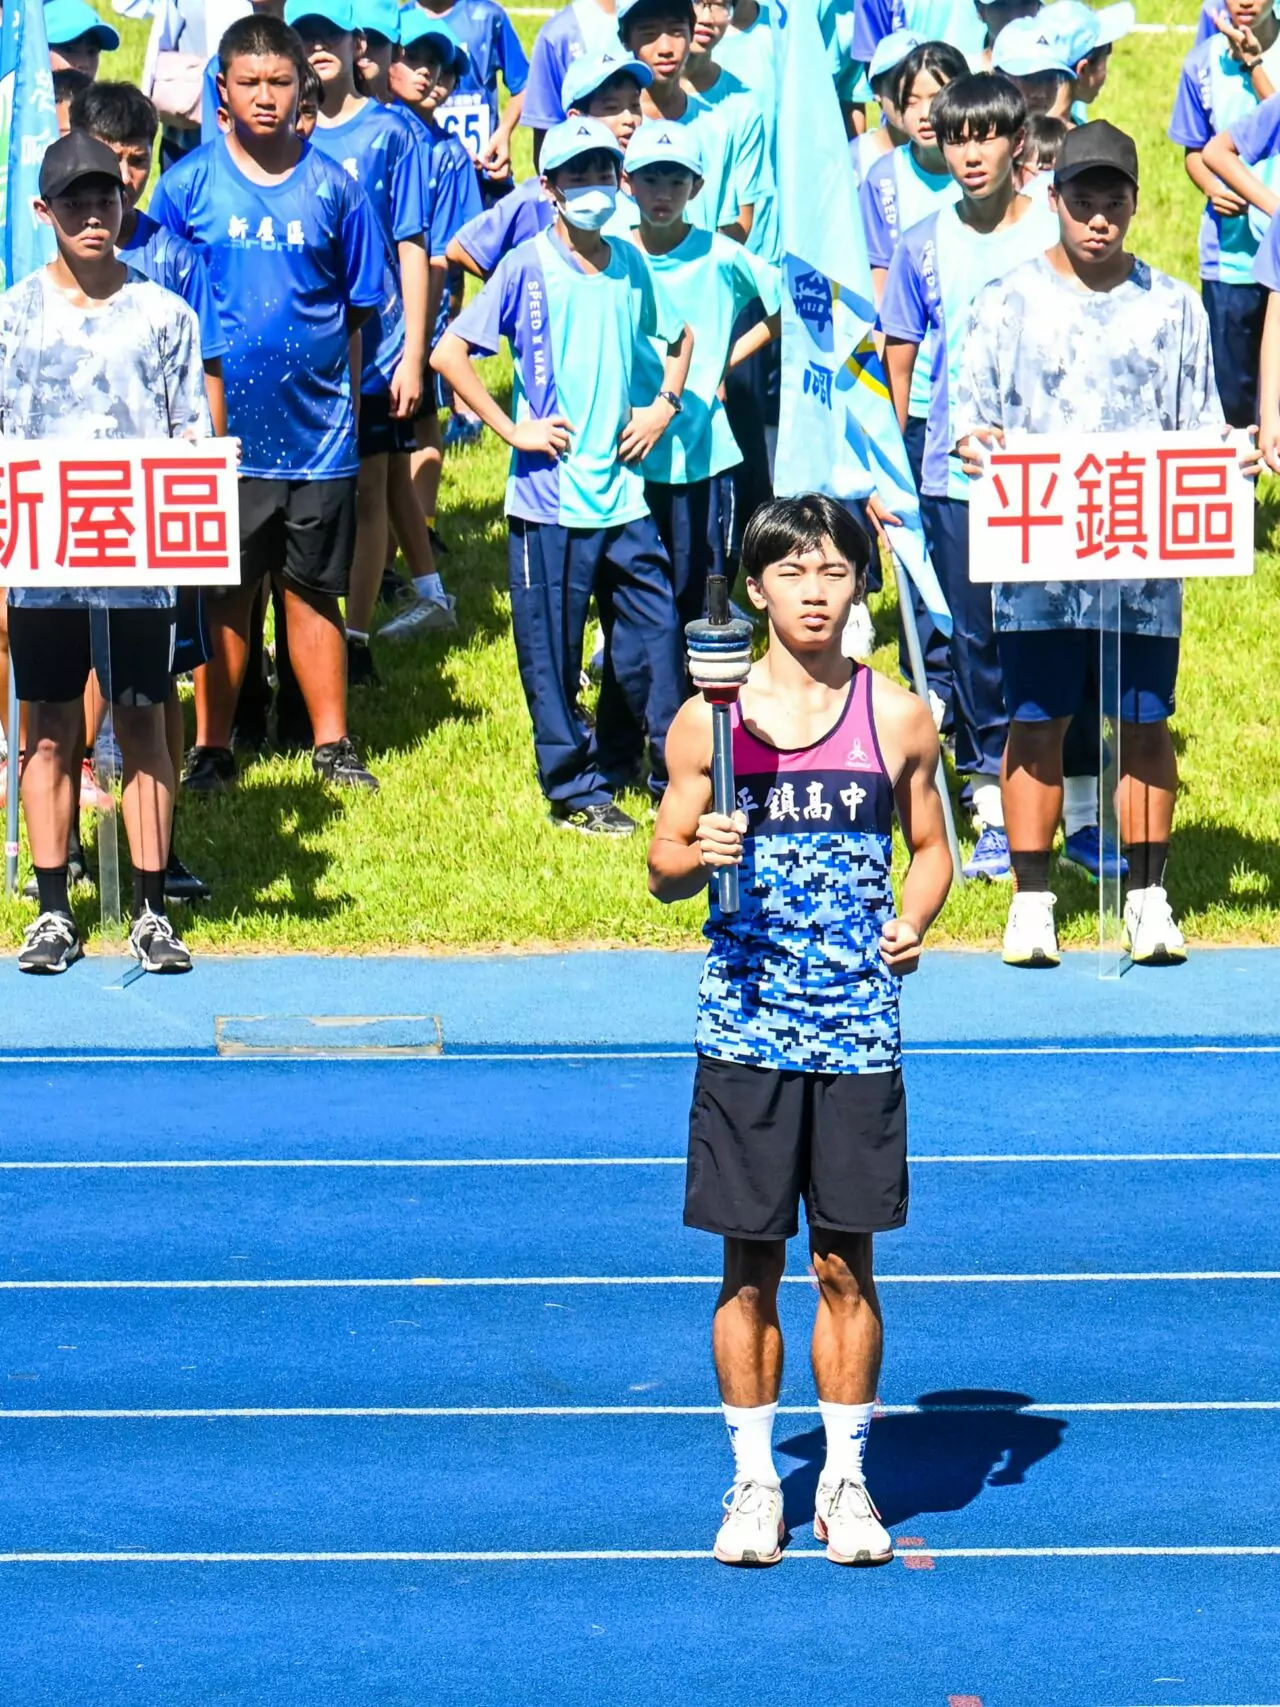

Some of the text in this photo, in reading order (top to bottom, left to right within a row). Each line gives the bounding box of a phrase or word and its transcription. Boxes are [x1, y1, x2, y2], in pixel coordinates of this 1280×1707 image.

[528, 281, 543, 331] SPEED
[534, 350, 547, 387] MAX
[0, 457, 229, 570] 新屋區
[987, 448, 1237, 564] 平鎮區
[736, 781, 867, 825] 平鎮高中
